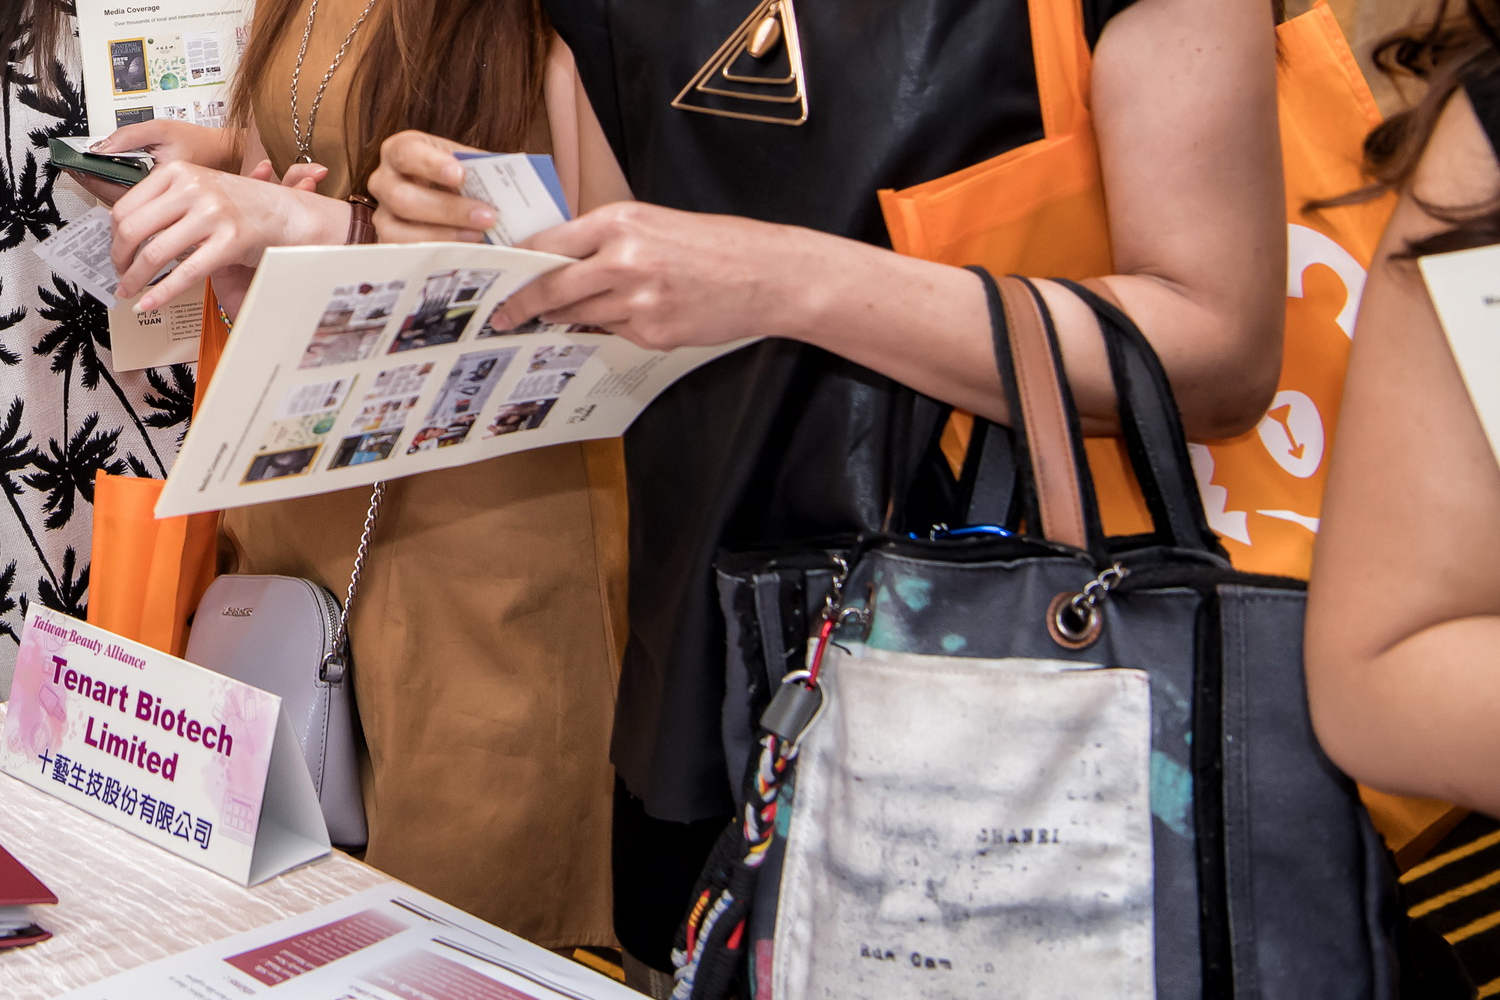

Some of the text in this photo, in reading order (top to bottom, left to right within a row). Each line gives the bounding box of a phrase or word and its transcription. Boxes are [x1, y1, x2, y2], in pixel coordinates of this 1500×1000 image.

[104, 5, 160, 16] Media Coverage
[126, 18, 150, 26] thousands
[178, 12, 205, 20] international
[138, 317, 162, 327] YUAN
[32, 614, 147, 671] Taiwan Beauty Alliance
[51, 655, 234, 757] Tenart Biotech
[84, 716, 180, 782] Limited
[37, 748, 213, 851] 十藝生技股份有限公司
